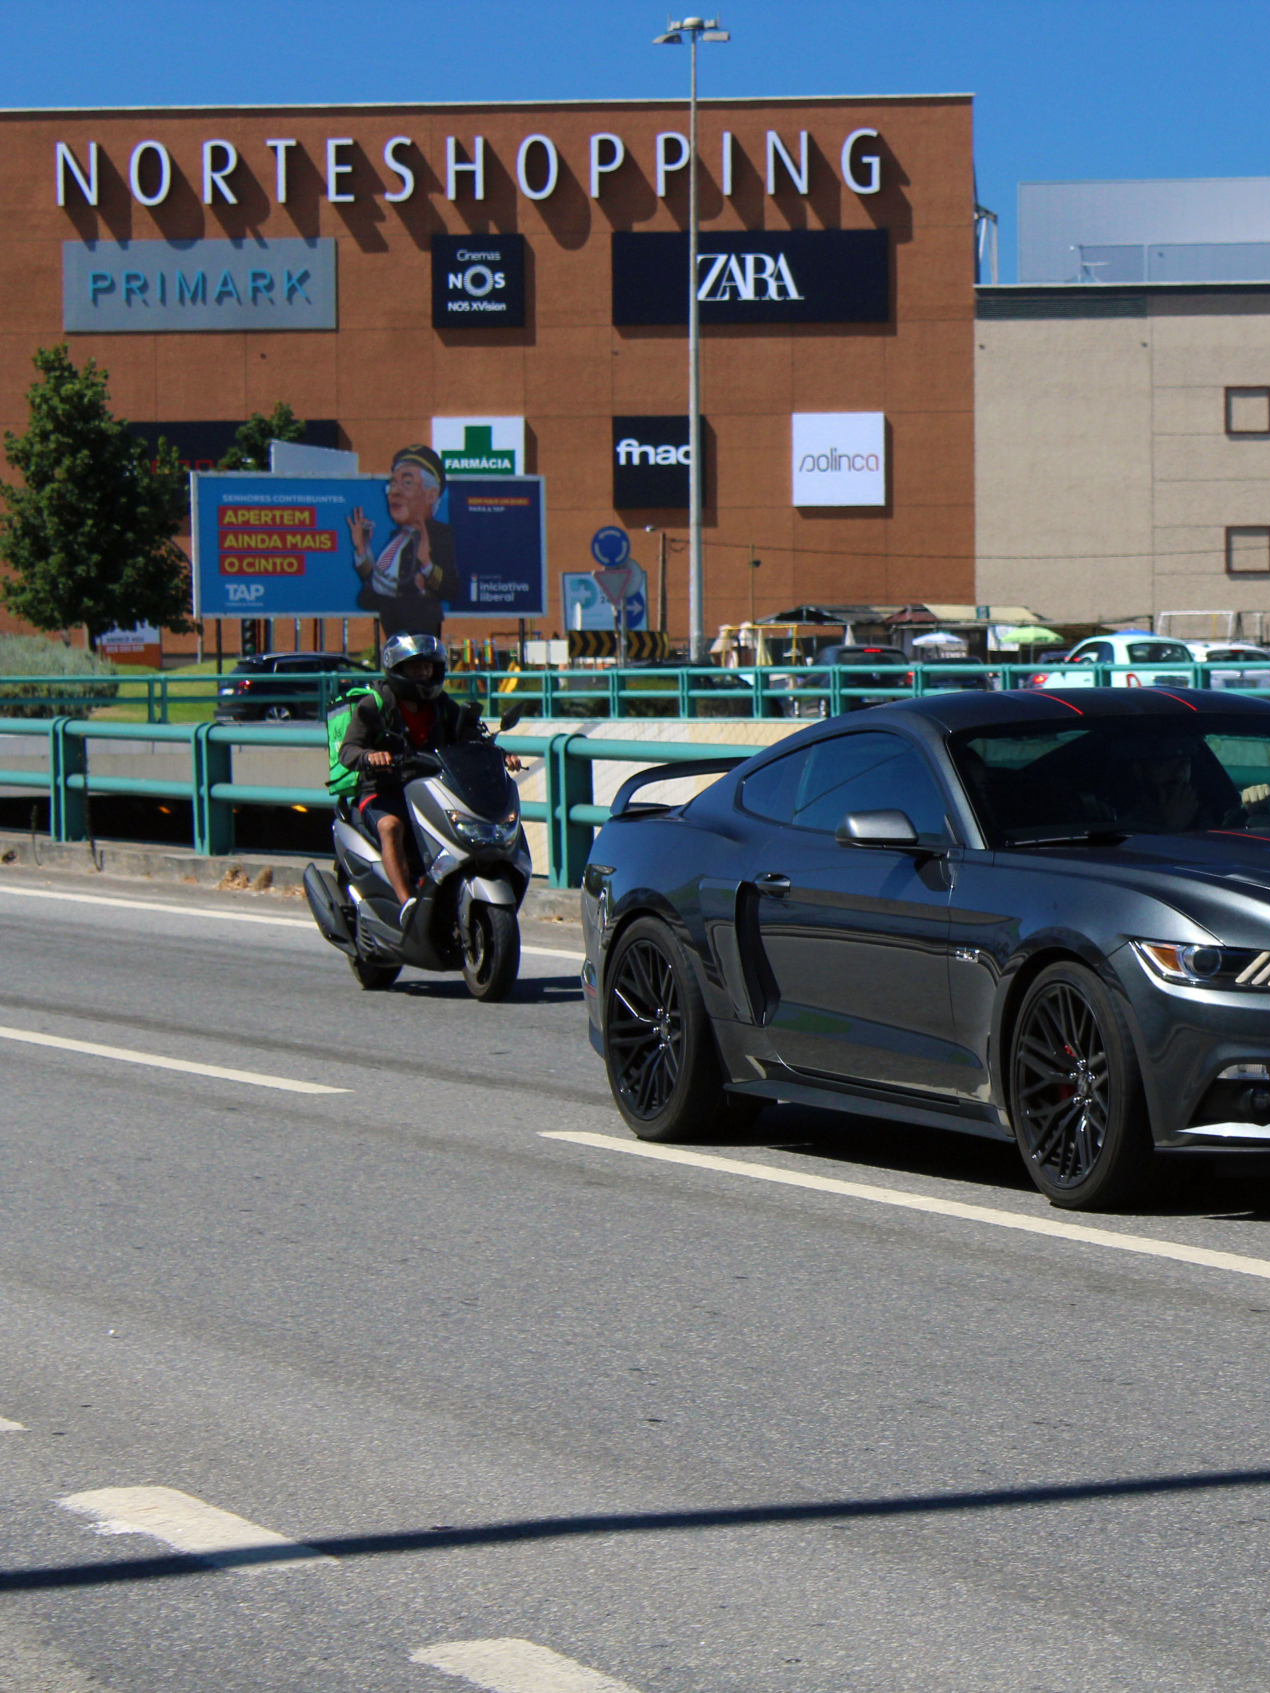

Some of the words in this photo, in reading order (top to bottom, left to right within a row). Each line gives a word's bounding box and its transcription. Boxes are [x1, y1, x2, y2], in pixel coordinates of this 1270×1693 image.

[56, 128, 882, 206] NORTESHOPPING
[456, 249, 501, 262] Cinemas
[448, 264, 506, 298] NOS
[696, 252, 805, 301] ZARA
[89, 268, 311, 302] PRIMARK
[447, 300, 470, 312] NOS
[471, 299, 507, 312] XVision
[444, 456, 512, 470] FARMÁCIA
[799, 447, 880, 473] solinca
[222, 494, 272, 503] SENHORES
[223, 509, 310, 526] APERTEM
[223, 533, 283, 549] AINDA
[286, 533, 332, 549] MAIS
[224, 557, 239, 573] O
[242, 557, 298, 573] CINTO
[225, 584, 265, 601] TAP
[480, 581, 529, 592] iniciativa
[480, 592, 515, 602] liberal
